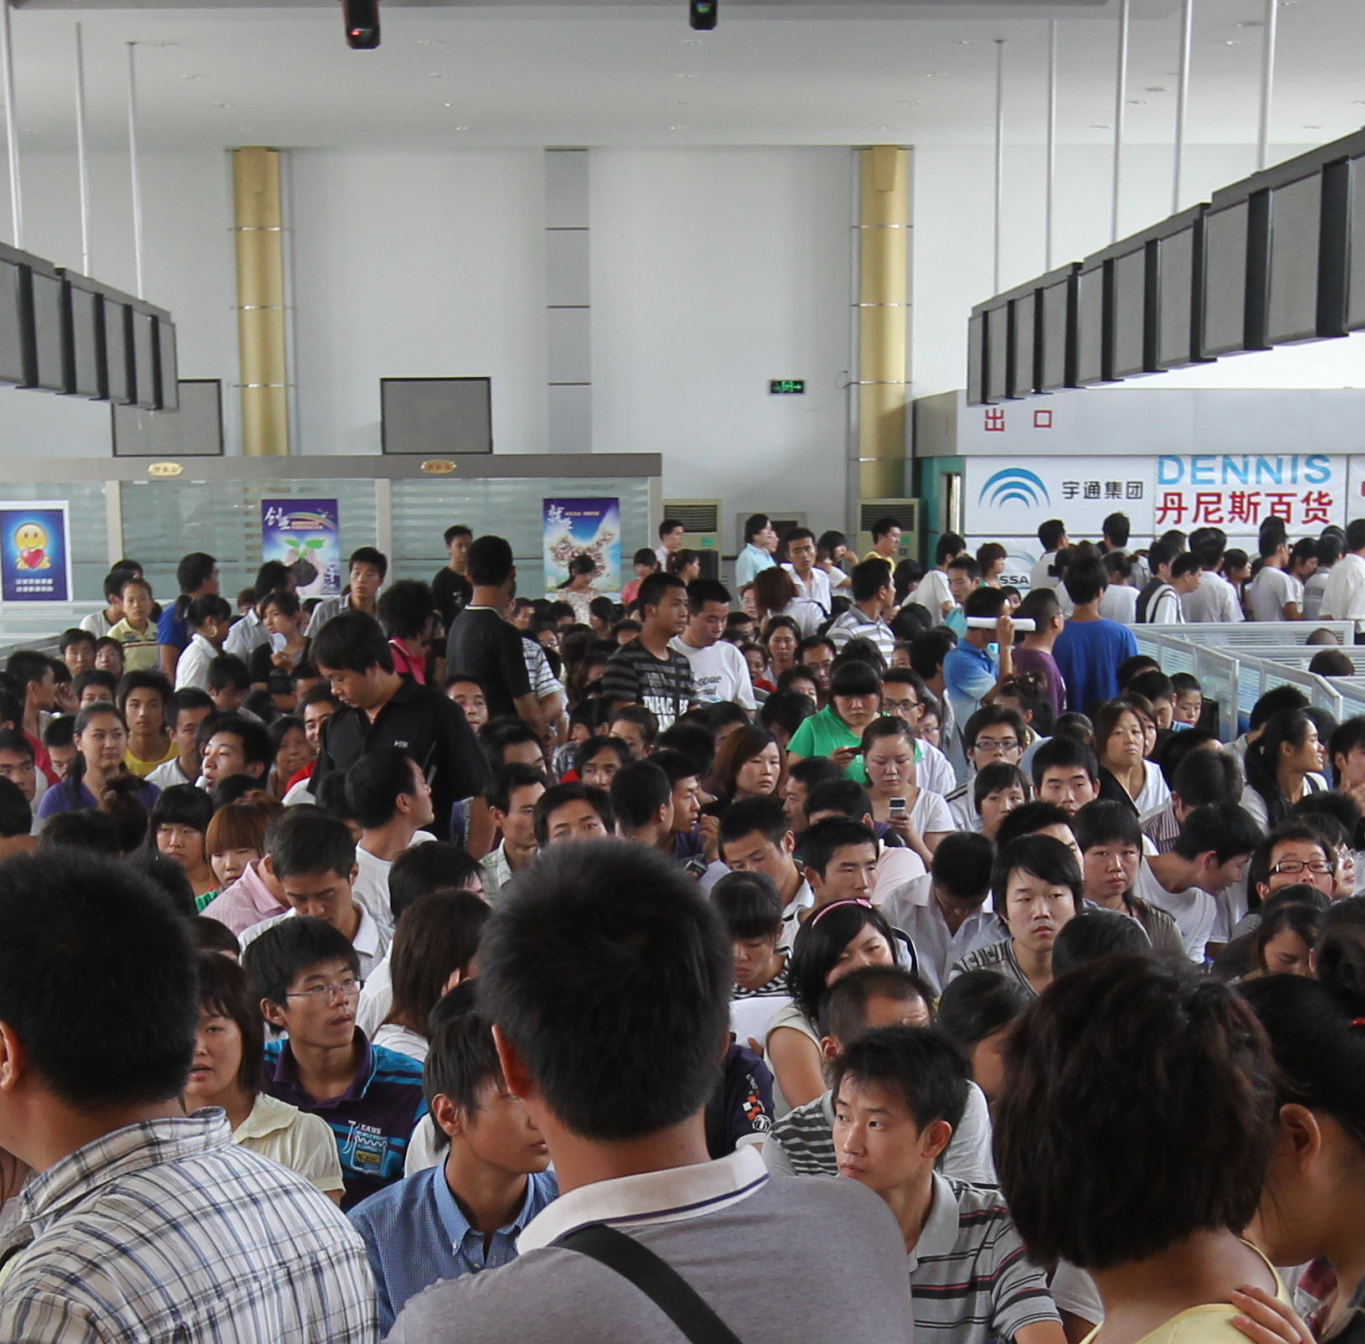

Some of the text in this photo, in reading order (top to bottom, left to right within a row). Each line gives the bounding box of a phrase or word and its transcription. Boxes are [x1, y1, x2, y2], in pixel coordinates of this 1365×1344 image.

[1157, 455, 1332, 485] DENNIS
[1061, 480, 1144, 500] 宇通集团
[1155, 490, 1333, 526] 丹尼斯百货
